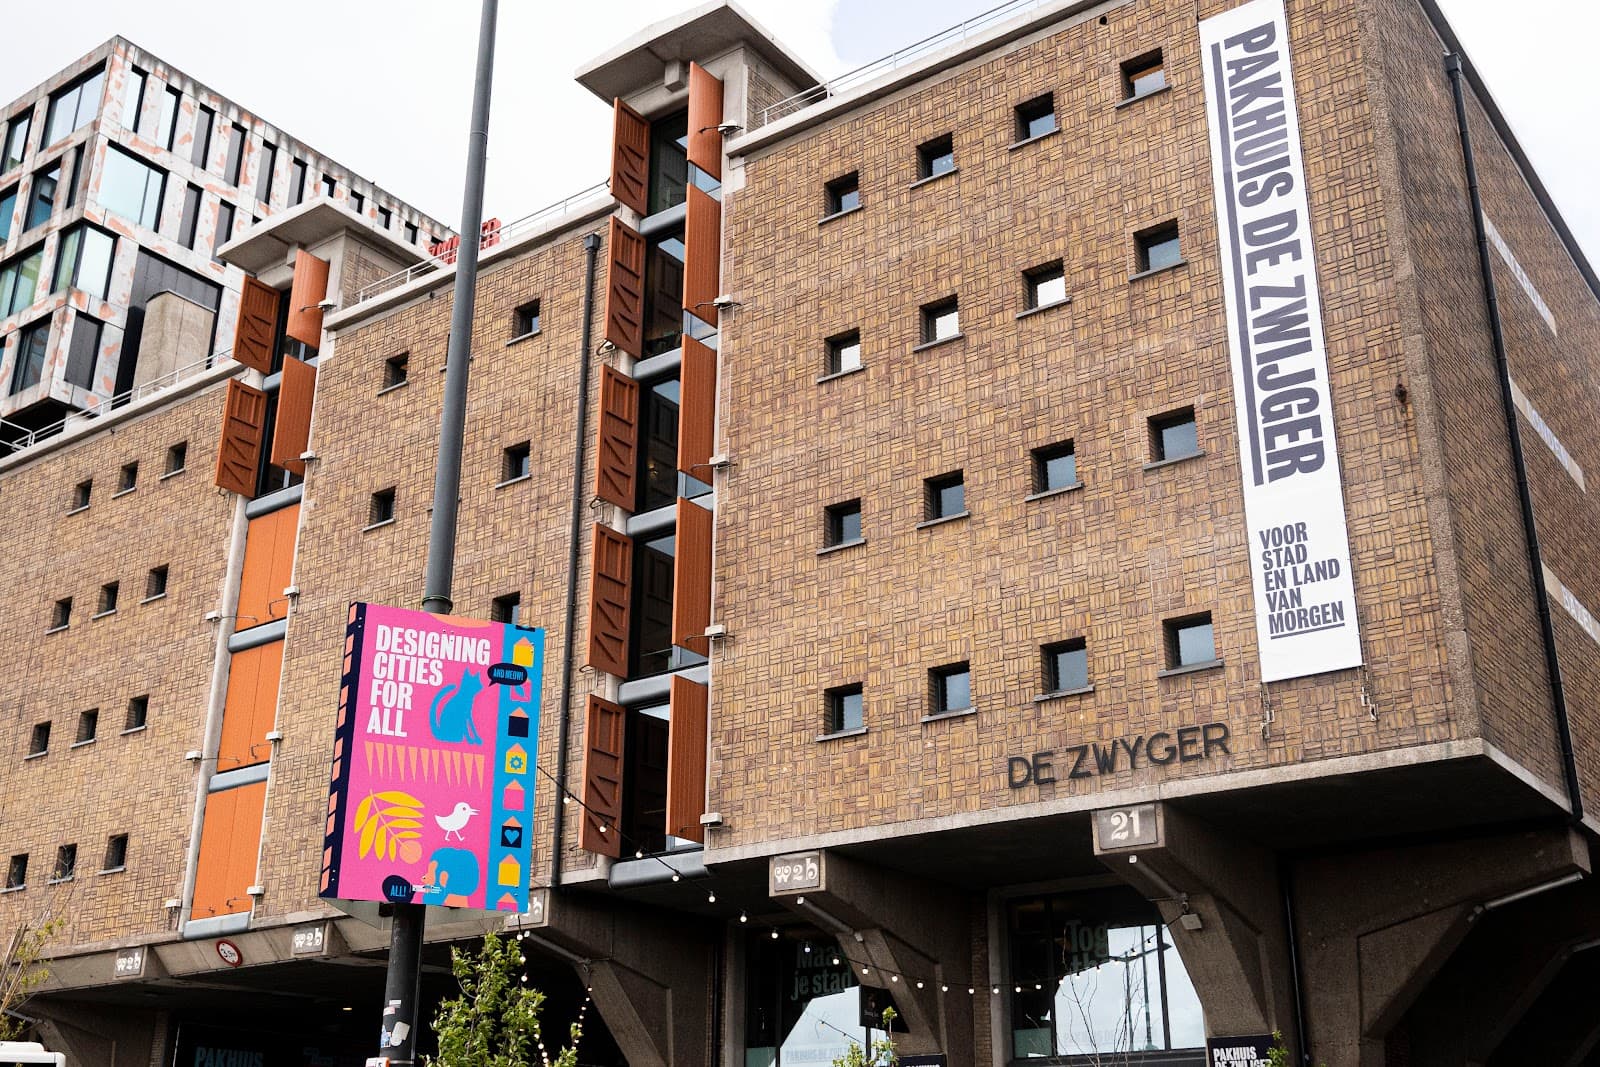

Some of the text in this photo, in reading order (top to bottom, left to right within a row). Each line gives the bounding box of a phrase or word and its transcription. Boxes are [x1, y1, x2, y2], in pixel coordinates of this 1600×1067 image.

[1223, 20, 1325, 483] PAKHUIS DE ZWIJGER
[1259, 521, 1308, 550] VOOR
[1262, 543, 1308, 571] STAD
[1264, 558, 1340, 592] EN LAND
[1265, 587, 1302, 613] VAN
[1268, 600, 1345, 635] MORGEN
[375, 624, 491, 666] DESIGNING
[373, 651, 443, 687] CITIES
[370, 678, 414, 711] FOR
[366, 706, 408, 738] ALL
[1008, 722, 1231, 789] DE ZWYGER
[1110, 809, 1141, 841] 21
[390, 884, 407, 897] ALL!
[1213, 1046, 1257, 1061] PAKHUIS
